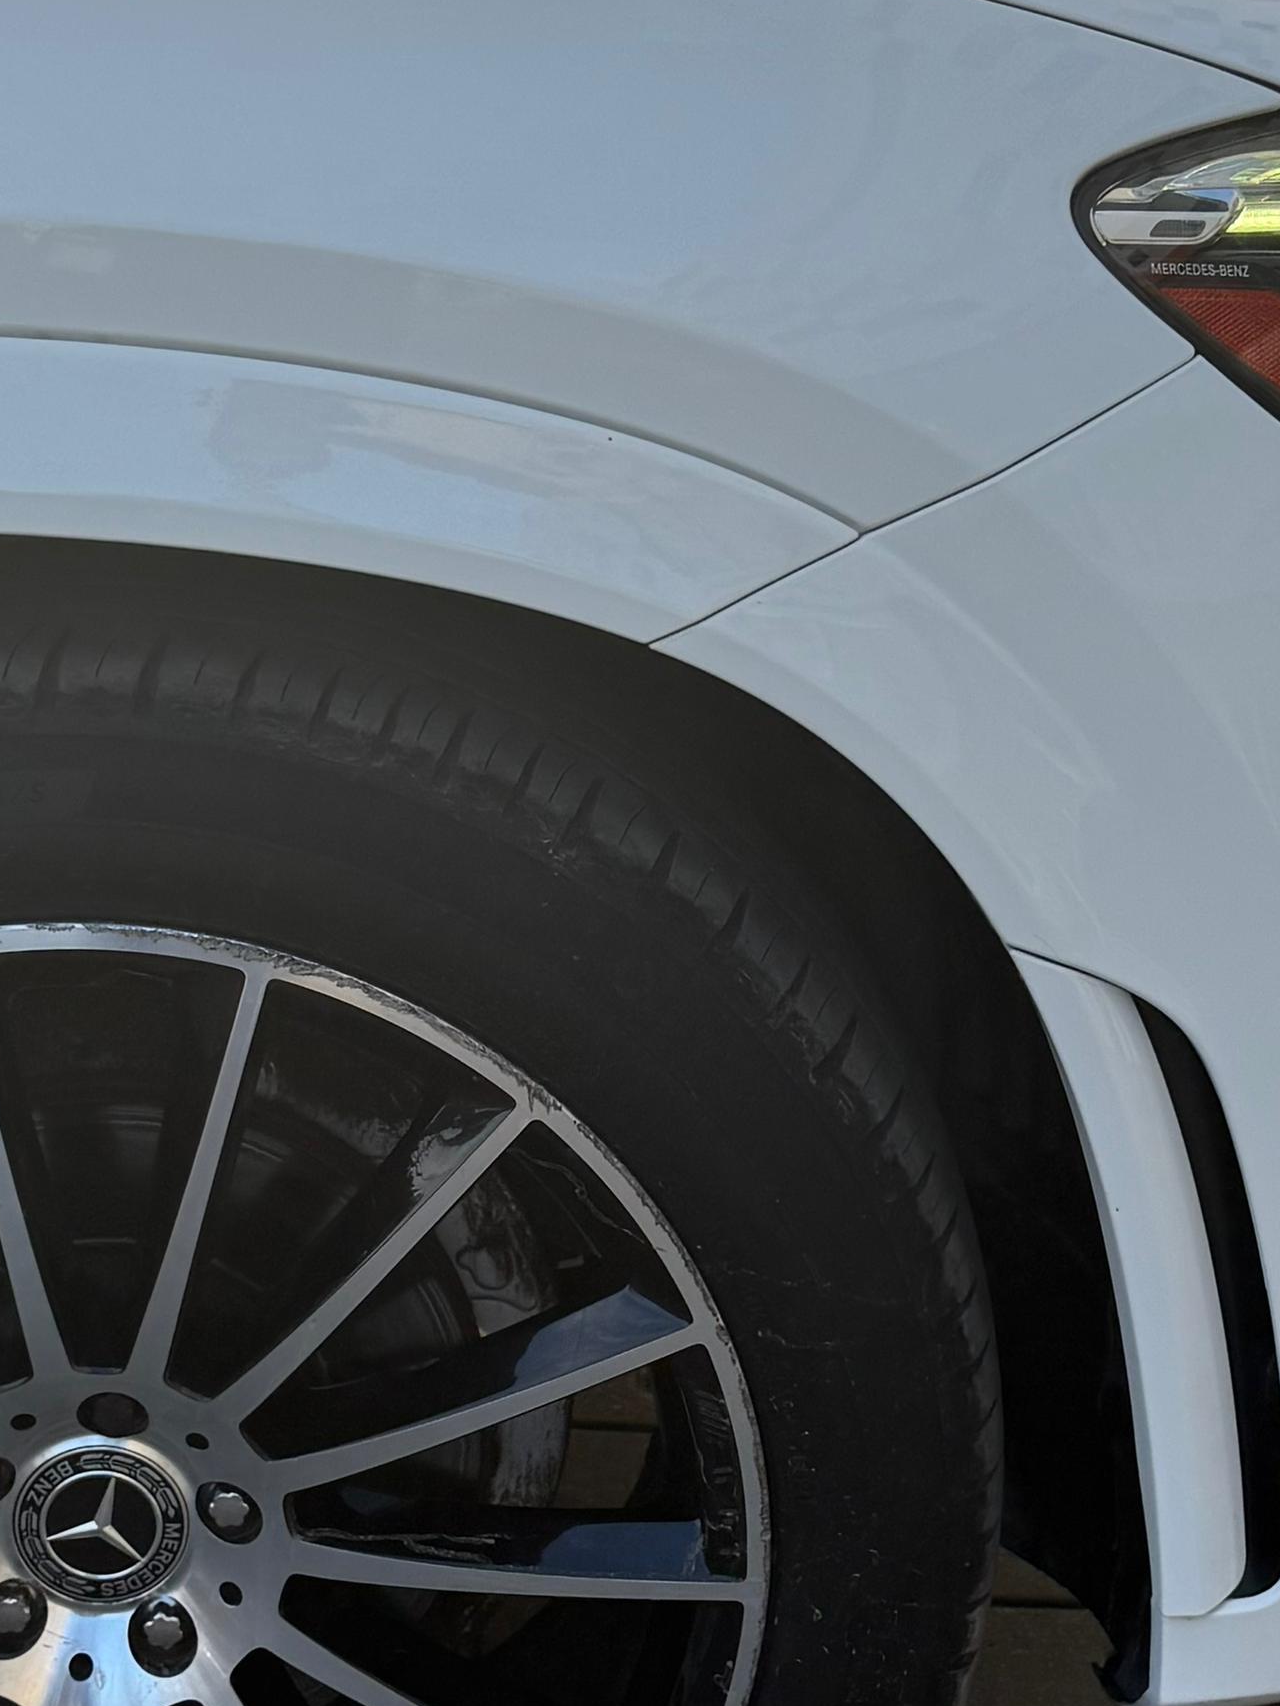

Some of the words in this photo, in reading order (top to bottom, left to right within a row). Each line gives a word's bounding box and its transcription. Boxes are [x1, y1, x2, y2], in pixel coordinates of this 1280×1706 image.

[1150, 263, 1250, 277] MERCEDES-BENZ
[26, 1460, 74, 1506] BENZ
[100, 1522, 182, 1596] MERCEDES
